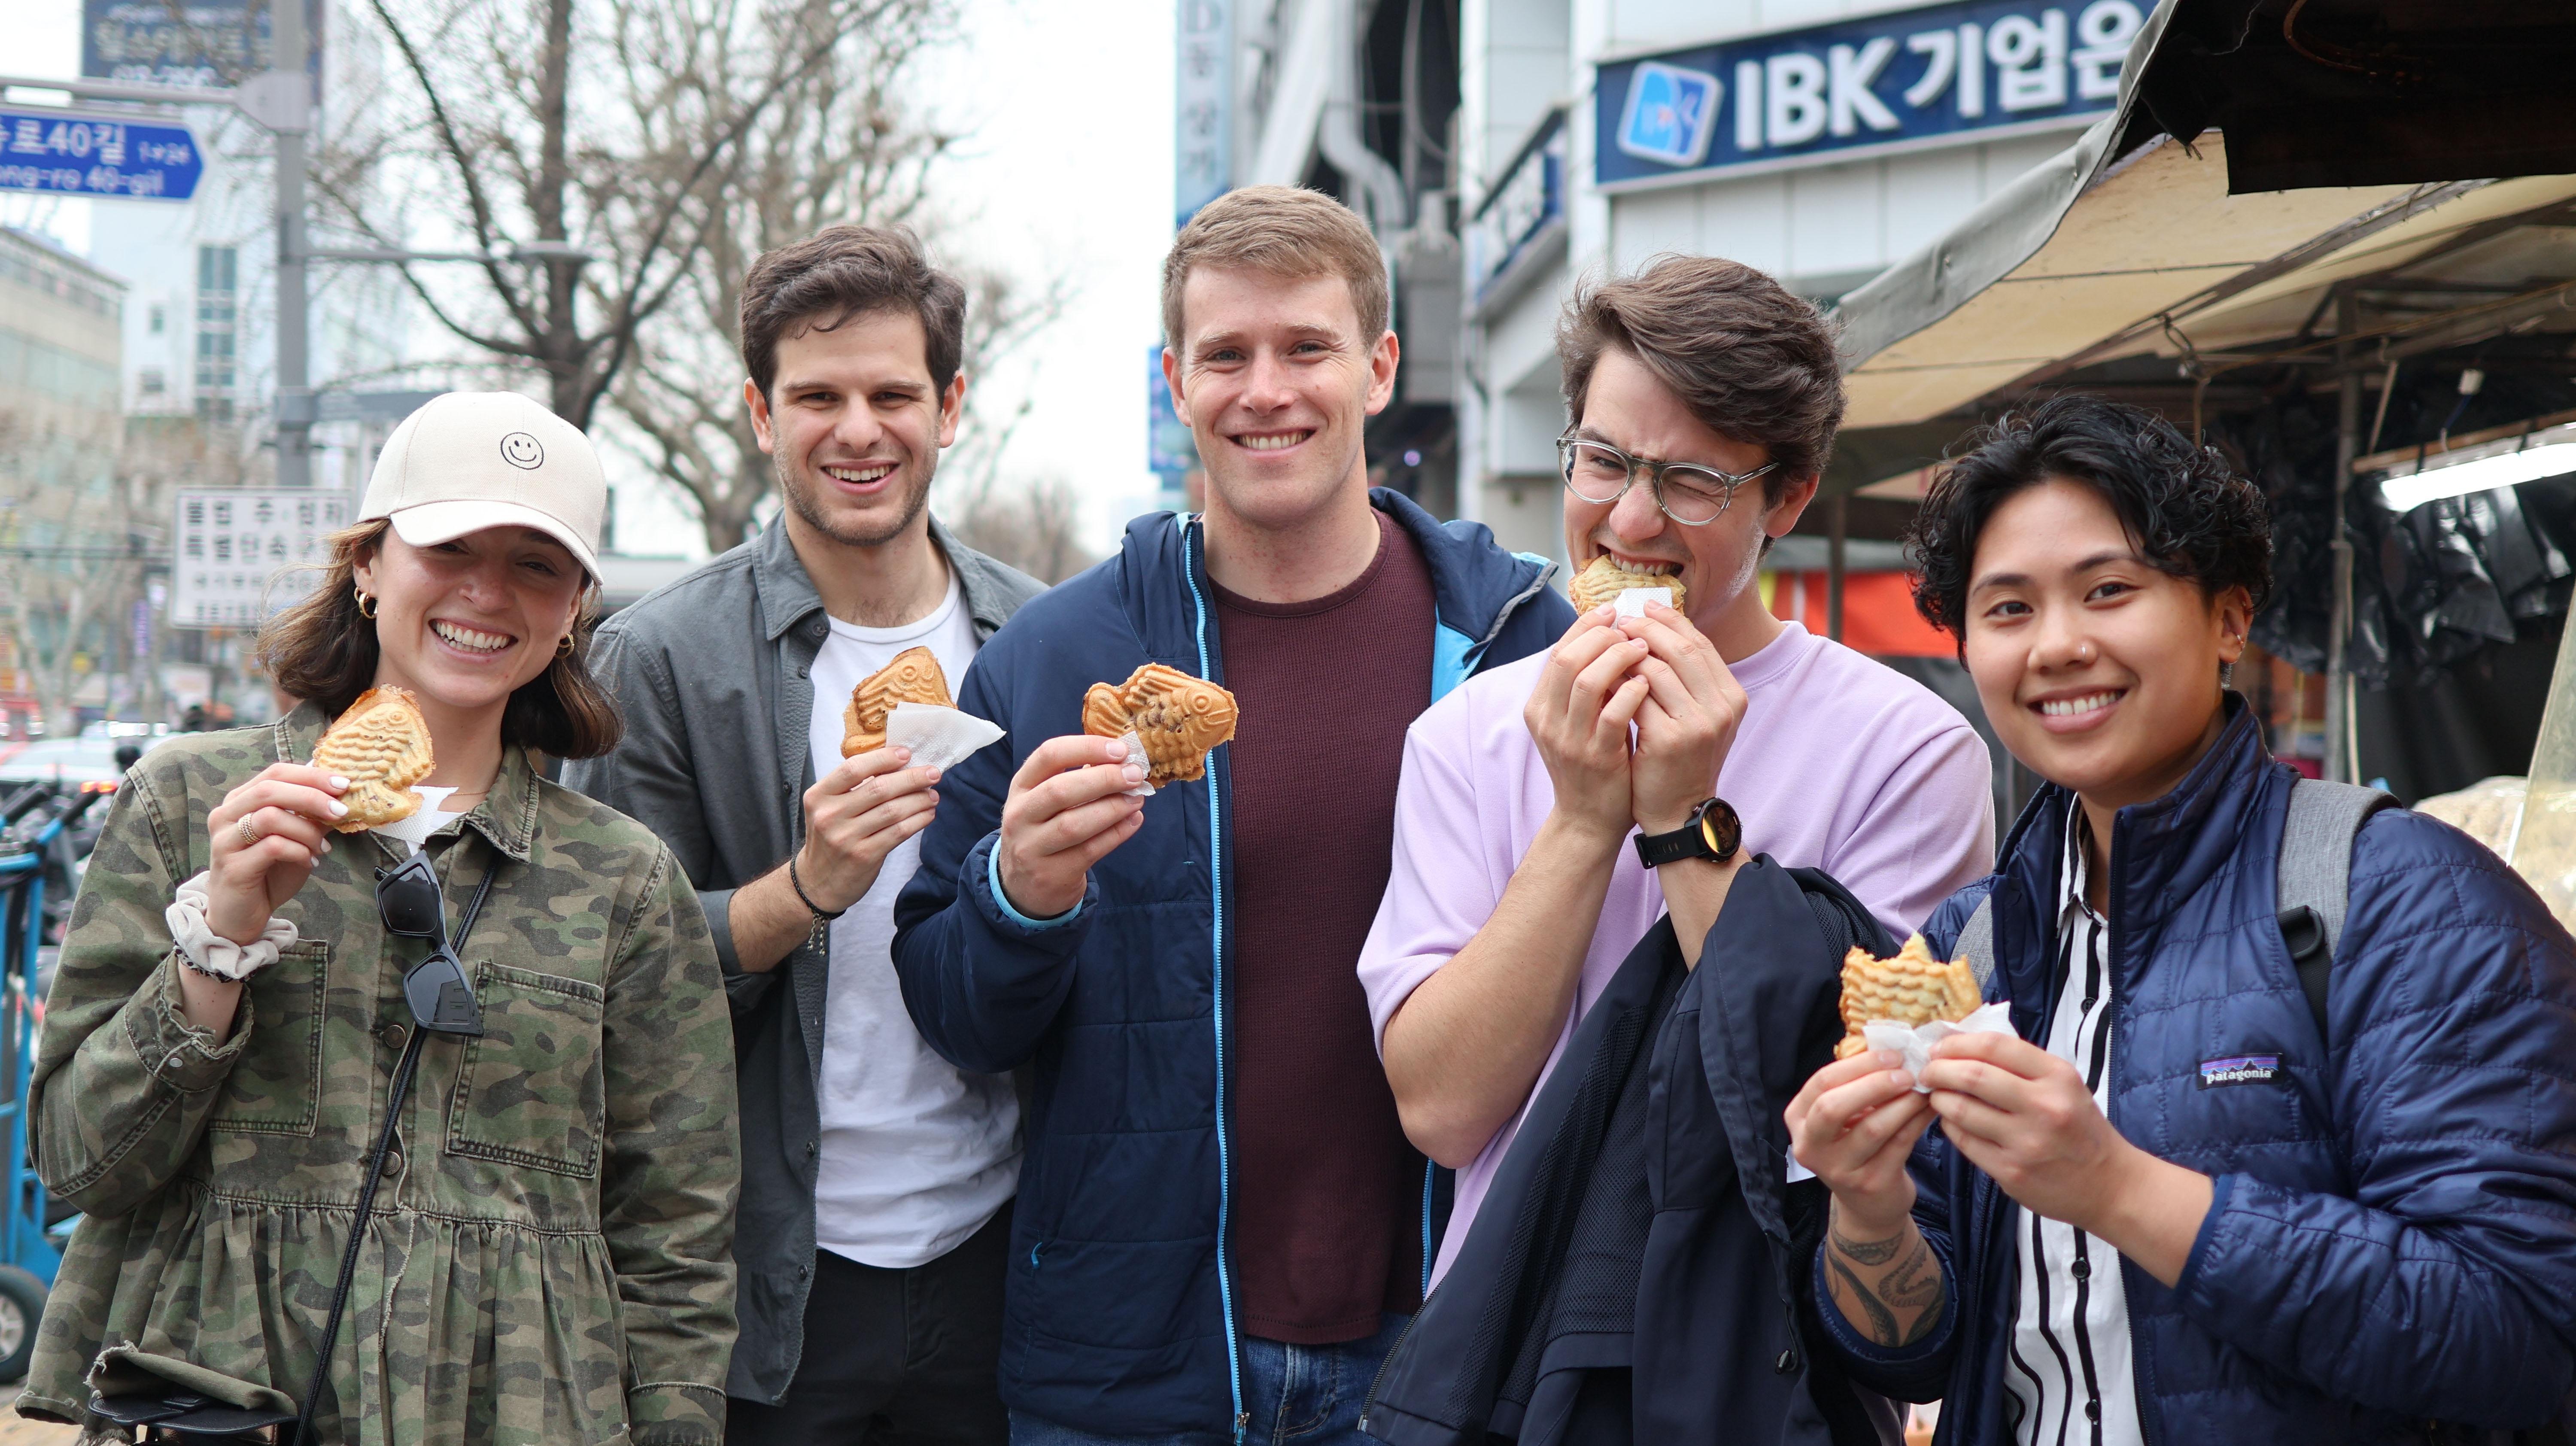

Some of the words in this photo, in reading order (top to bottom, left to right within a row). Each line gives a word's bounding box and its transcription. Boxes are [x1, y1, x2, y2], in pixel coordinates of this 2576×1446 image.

[1734, 37, 1901, 152] IBK
[0, 118, 126, 167] 로40길
[0, 164, 82, 191] ng-ro
[86, 165, 164, 196] 40-gil
[2206, 1068, 2272, 1084] patagonia
